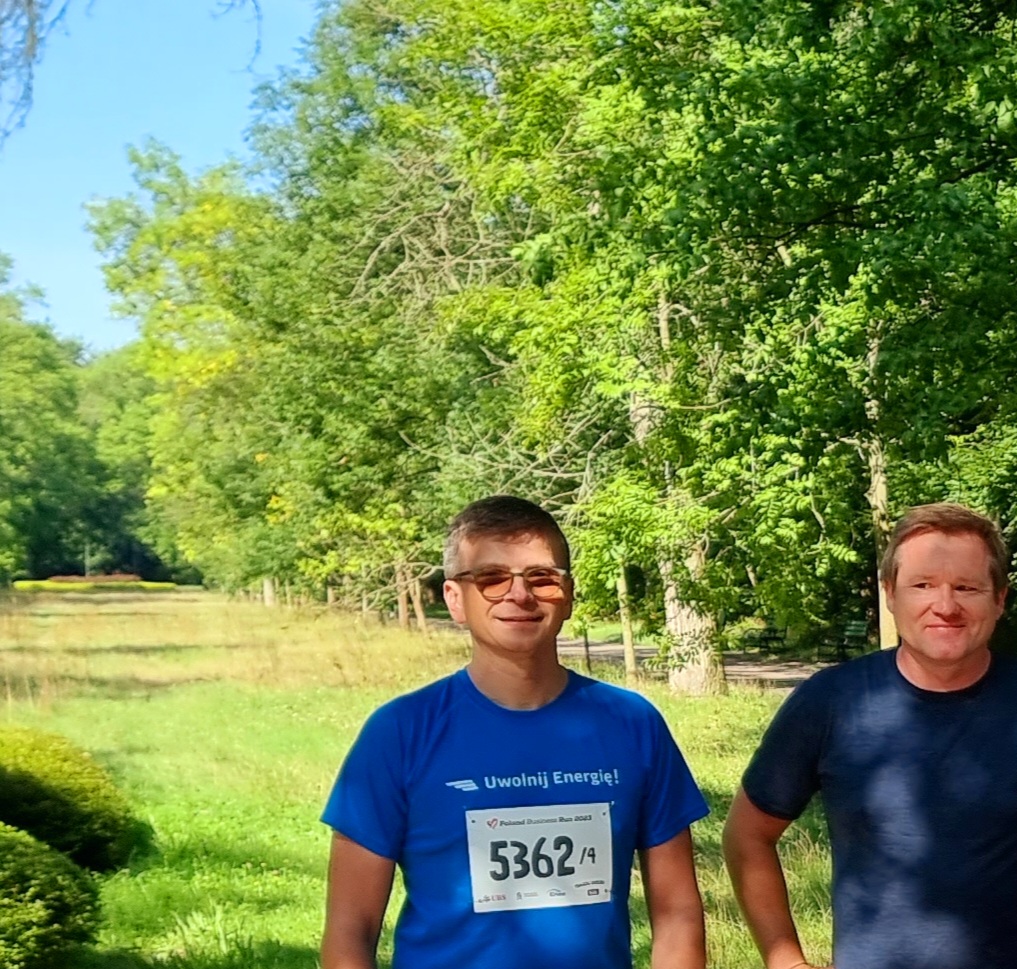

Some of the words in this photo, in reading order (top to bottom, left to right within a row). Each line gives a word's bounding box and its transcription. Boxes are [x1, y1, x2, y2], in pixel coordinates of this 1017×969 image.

[484, 772, 548, 789] Uwolnij
[553, 769, 619, 786] Energię!
[489, 835, 575, 881] 5362
